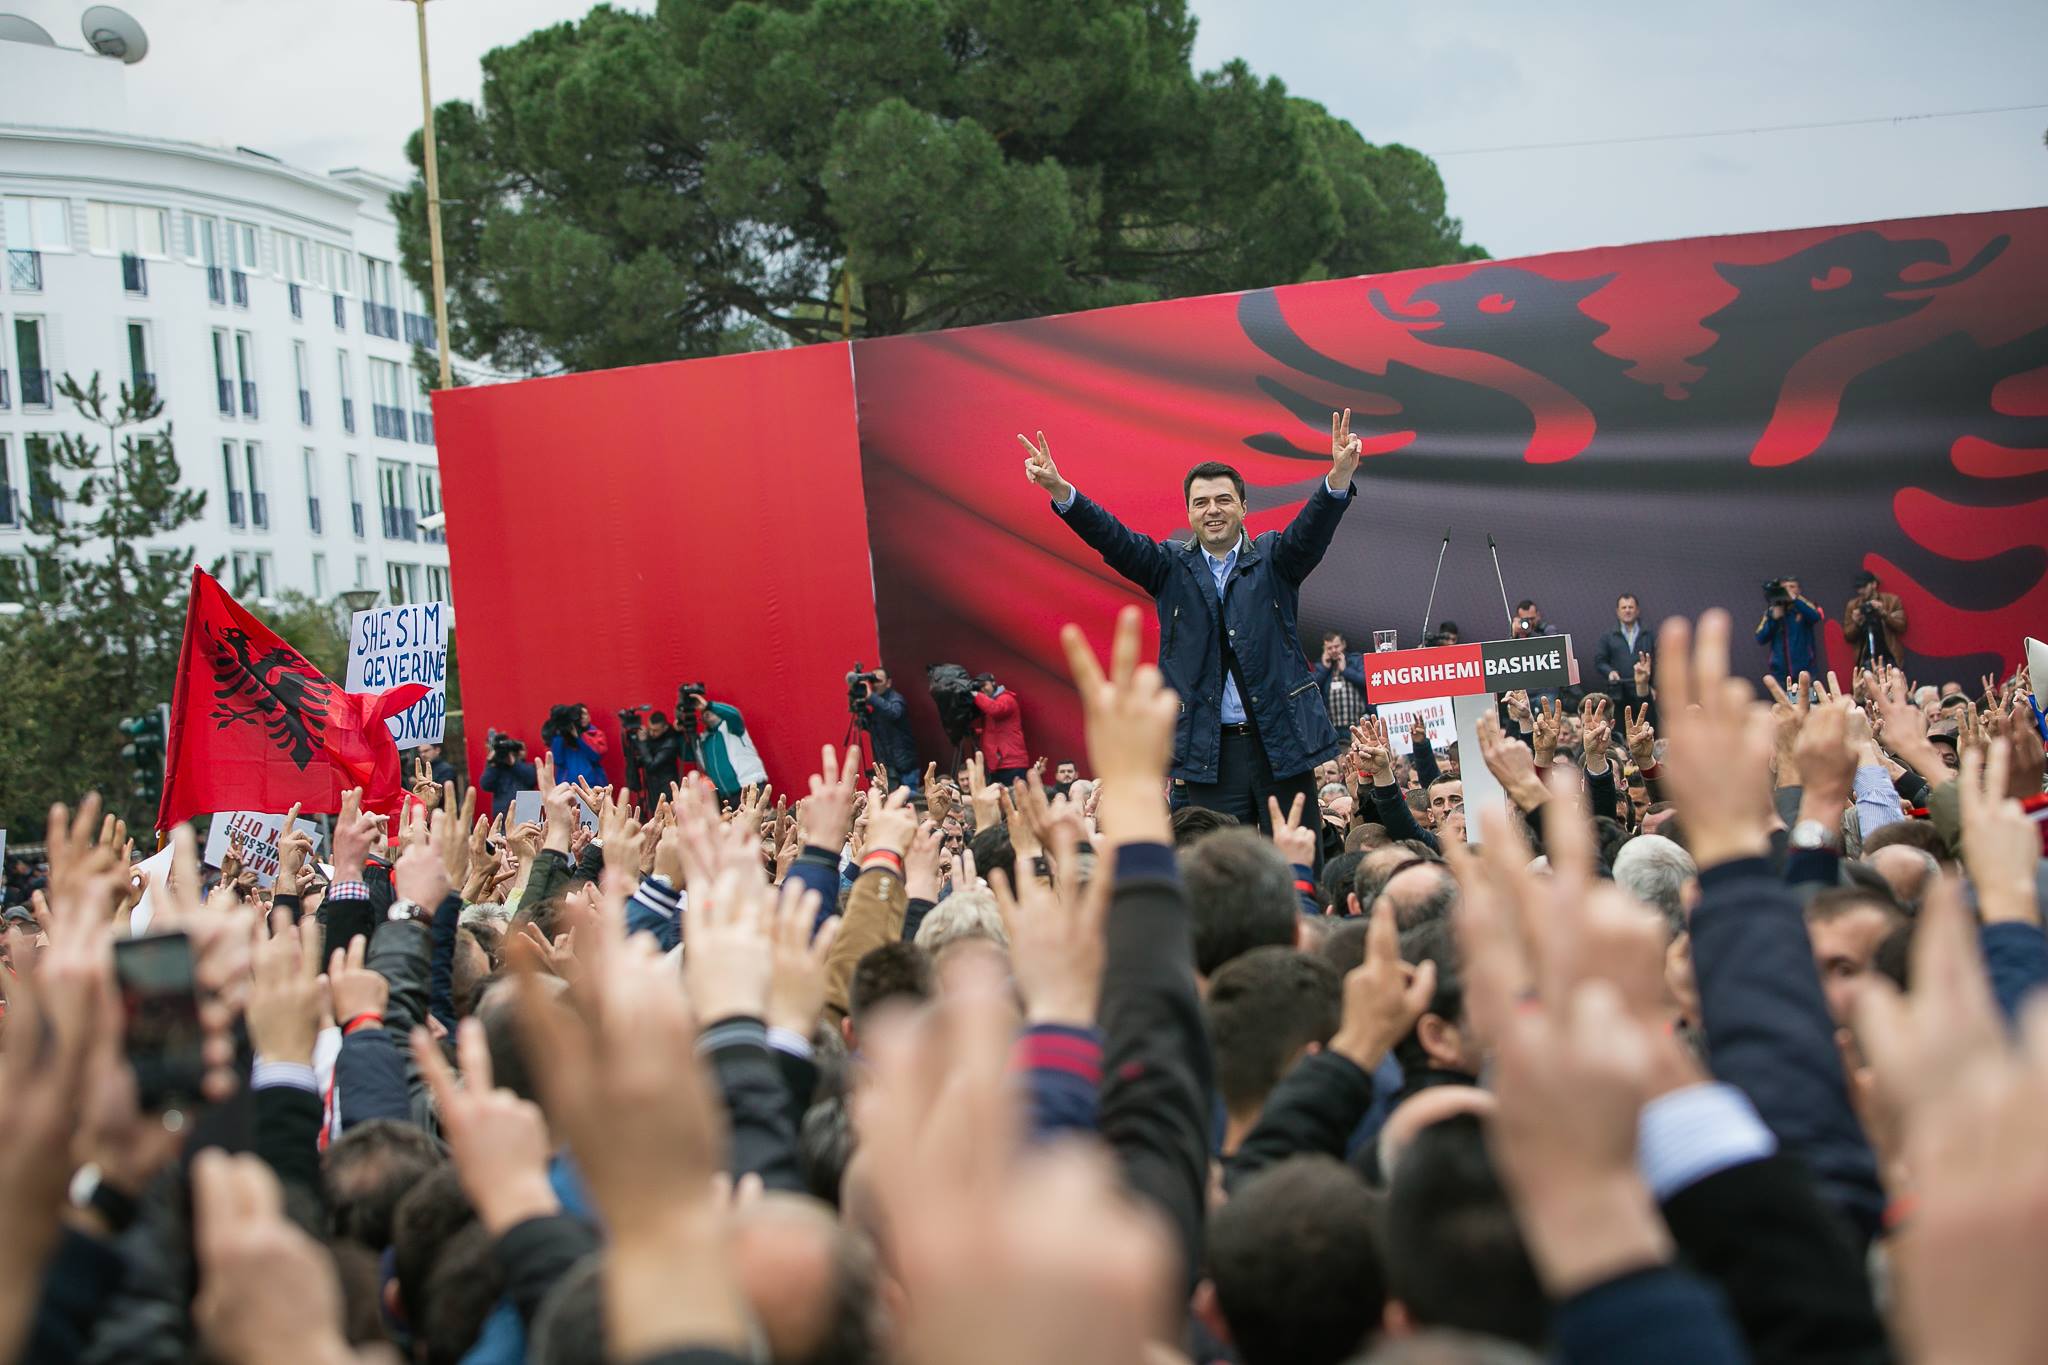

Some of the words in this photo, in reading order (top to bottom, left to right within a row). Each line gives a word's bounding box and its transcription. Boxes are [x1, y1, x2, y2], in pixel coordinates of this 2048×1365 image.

[363, 644, 446, 687] QEVERINË
[1371, 660, 1481, 687] #NGRIHEMI
[1484, 650, 1562, 675] BASHKË
[241, 849, 279, 876] MAFI
